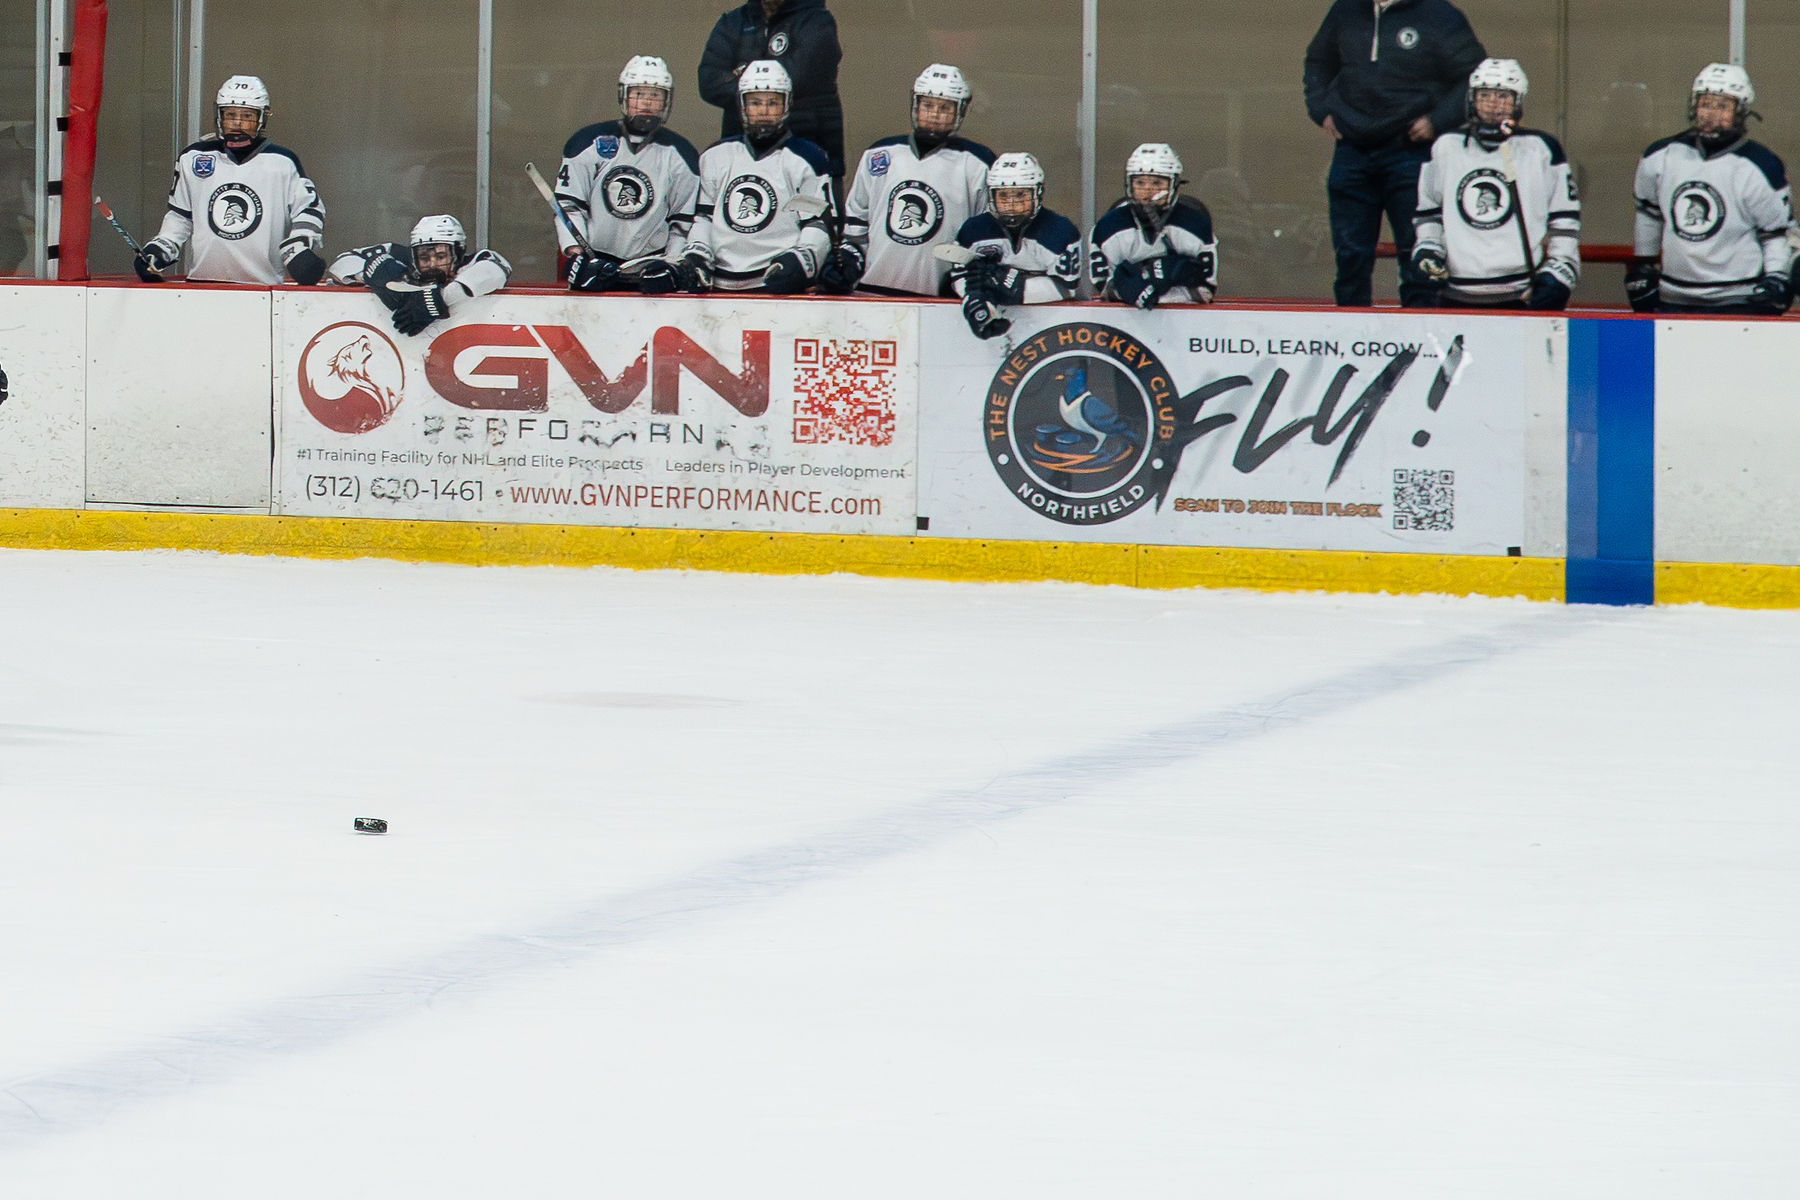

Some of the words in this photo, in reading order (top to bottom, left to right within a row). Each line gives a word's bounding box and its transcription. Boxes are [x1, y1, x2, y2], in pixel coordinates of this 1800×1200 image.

[1189, 338, 1260, 356] BUILD,
[1268, 340, 1345, 358] LEARN,
[424, 323, 771, 418] GVN
[990, 393, 1008, 441] THE
[1000, 337, 1049, 385] NEST
[1057, 328, 1153, 370] HOCKEY
[1151, 376, 1176, 441] CLUB
[315, 449, 376, 466] Training
[381, 451, 433, 467] Facility
[437, 452, 459, 465] for
[462, 454, 498, 466] NHL
[499, 455, 527, 467] and
[531, 456, 564, 468] Elite
[569, 456, 643, 474] Prospects
[666, 459, 725, 474] Leaders
[729, 460, 743, 474] in
[748, 461, 796, 477] Player
[800, 463, 906, 481] Development
[305, 474, 361, 503] (312)
[510, 482, 882, 516] www.GVNPERFORMANCE.com
[1017, 482, 1146, 520] NORTHFIELD
